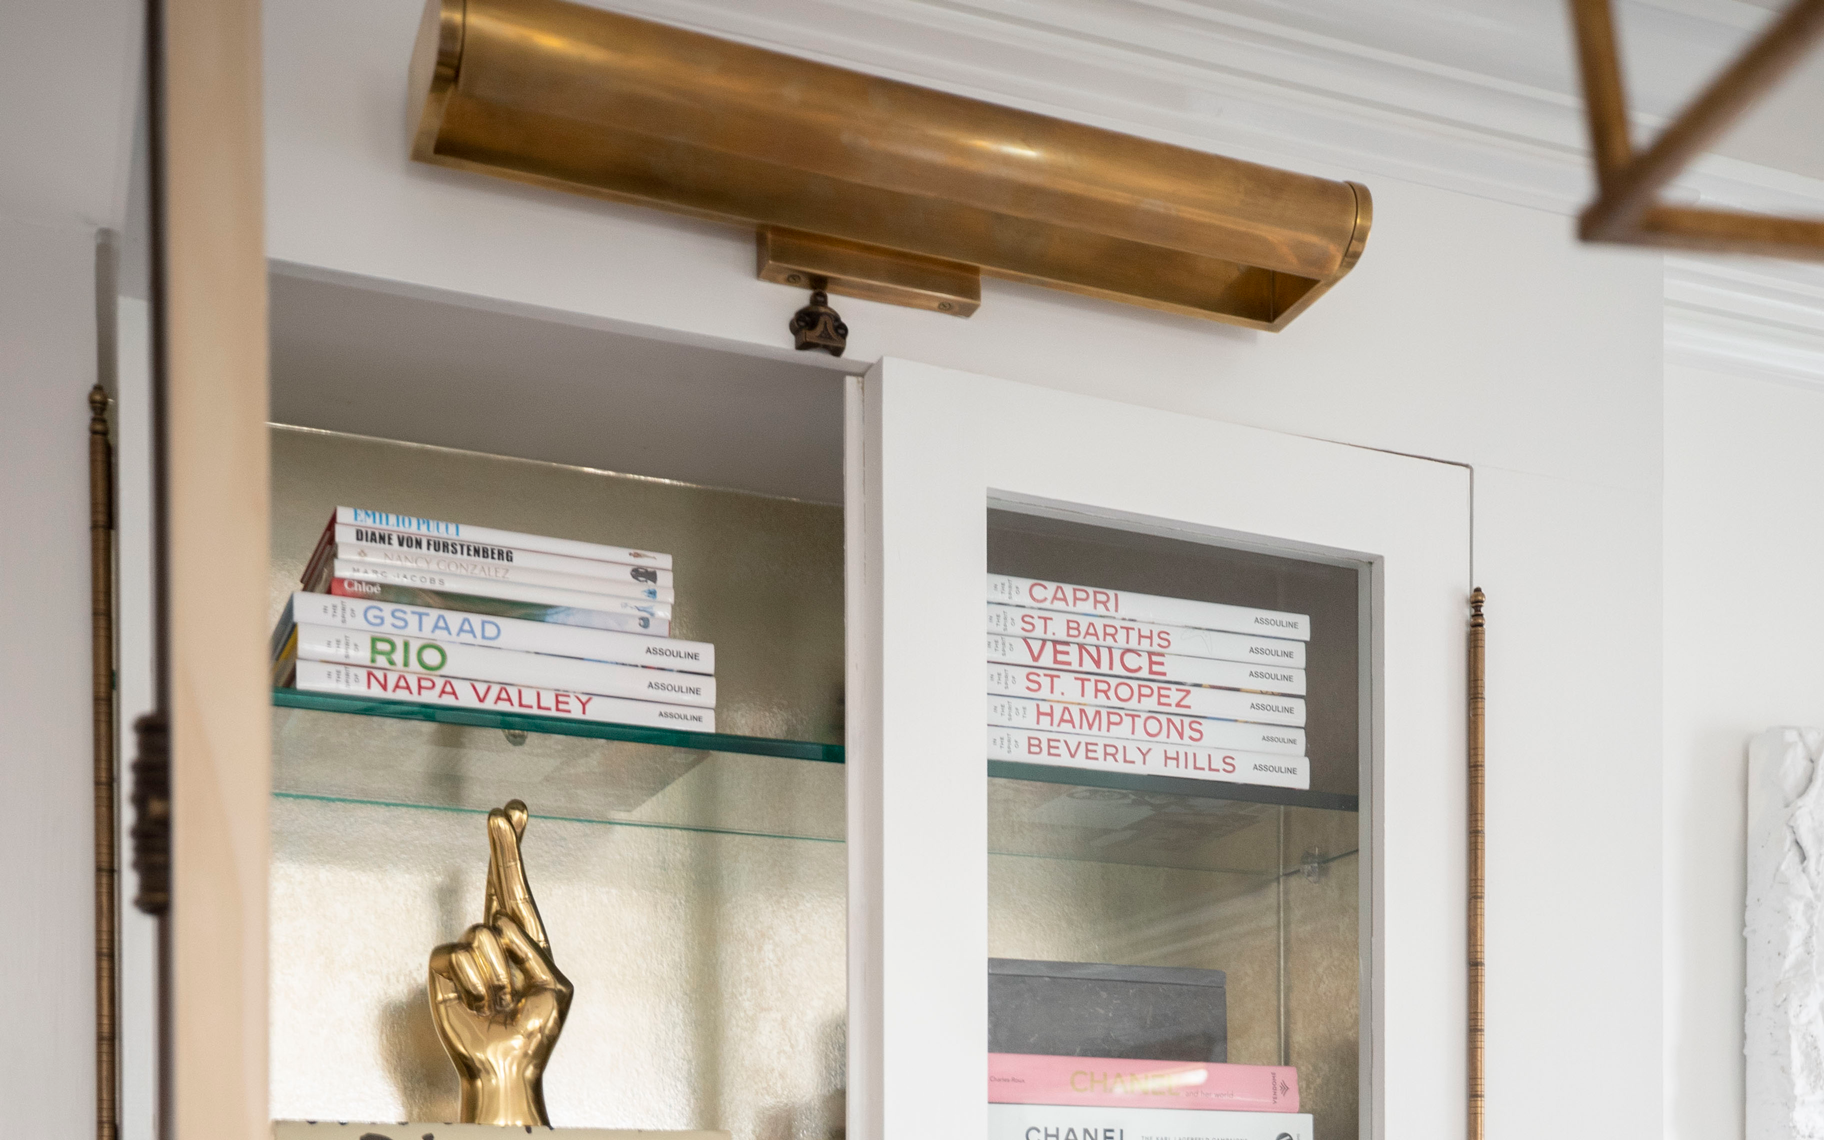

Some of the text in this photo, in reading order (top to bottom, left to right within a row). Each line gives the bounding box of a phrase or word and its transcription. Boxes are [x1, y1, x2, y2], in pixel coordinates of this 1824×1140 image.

[353, 508, 412, 531] EMILIO
[355, 528, 514, 563] DIANE VON FURSTENBERG
[352, 566, 446, 586] MARC JACOBS
[384, 552, 511, 580] NANCY GONZALEZ
[343, 579, 382, 594] Chloé
[1028, 582, 1120, 613] CAPRI
[363, 604, 501, 642] GSTAAD
[1020, 614, 1172, 649] ST. BARTHS
[1254, 616, 1299, 629] ASSOULINE
[369, 635, 448, 671] RIO
[645, 646, 700, 661] ASSOULINE
[1022, 637, 1167, 677] VENICE
[1249, 646, 1294, 659] ASSOULINE
[1249, 669, 1294, 683] ASSOULINE
[366, 669, 594, 715] NAPA VALLEY
[647, 680, 702, 696] ASSOULINE
[1025, 671, 1192, 709] ST. TROPEZ
[658, 709, 704, 723] ASSOULINE
[1250, 702, 1295, 714] ASSOULINE
[1036, 703, 1204, 742] HAMPTONS
[1261, 734, 1298, 745] ASSOULINE
[1027, 735, 1237, 774] BEVERLY HILLS
[1252, 763, 1298, 775] ASSOULINE
[1185, 1090, 1199, 1098] and
[1201, 1090, 1212, 1098] her
